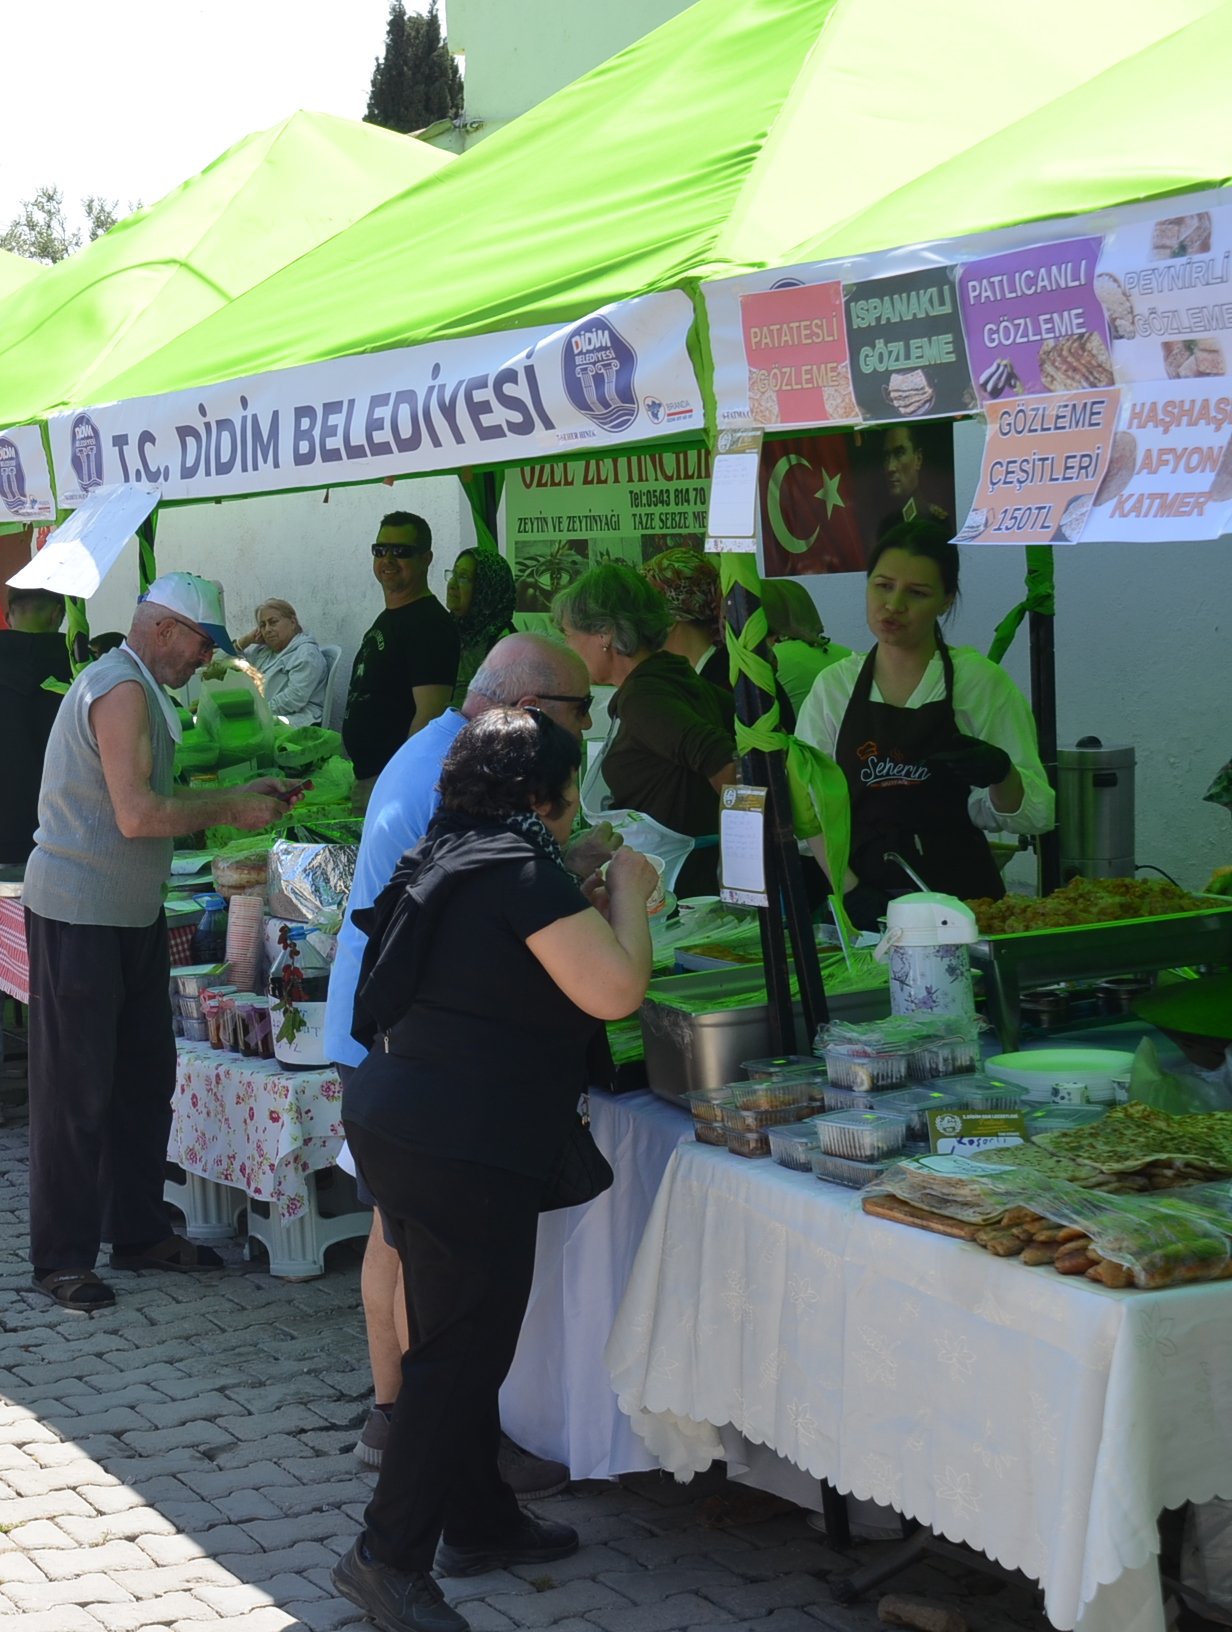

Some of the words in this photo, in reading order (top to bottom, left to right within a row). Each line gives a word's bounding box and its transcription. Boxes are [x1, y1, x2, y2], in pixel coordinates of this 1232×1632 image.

[968, 259, 1086, 305] PATLICANLI
[1124, 250, 1231, 297] PEYNİRLİ
[850, 284, 951, 328] ISPANAKLI
[1132, 302, 1232, 338] GÖZLEME
[571, 328, 611, 354] DİDİM
[750, 311, 838, 349] PATATESLİ
[983, 309, 1086, 349] GÖZLEME
[574, 348, 616, 365] BELEDİYESİ
[859, 334, 956, 373] GÖZLEME
[756, 362, 839, 393] GÖZLEME
[112, 429, 170, 484] T.C.
[175, 394, 281, 480] DİDİM
[291, 349, 556, 465] BELEDİYESİ
[998, 400, 1105, 437] GÖZLEME
[988, 451, 1100, 493] ÇEŞİTLERİ
[1135, 446, 1223, 475] AFYON
[629, 489, 671, 508] Tel:0543
[674, 488, 690, 507] 814
[1109, 491, 1211, 519] KATMER
[517, 511, 550, 534] ZEYTİN
[551, 515, 564, 533] VE
[566, 508, 621, 533] ZEYTİNYAĞI
[632, 512, 656, 531] TAZE
[658, 511, 689, 530] SEBZE
[992, 504, 1054, 534] 150TL
[860, 755, 932, 782] Seherin
